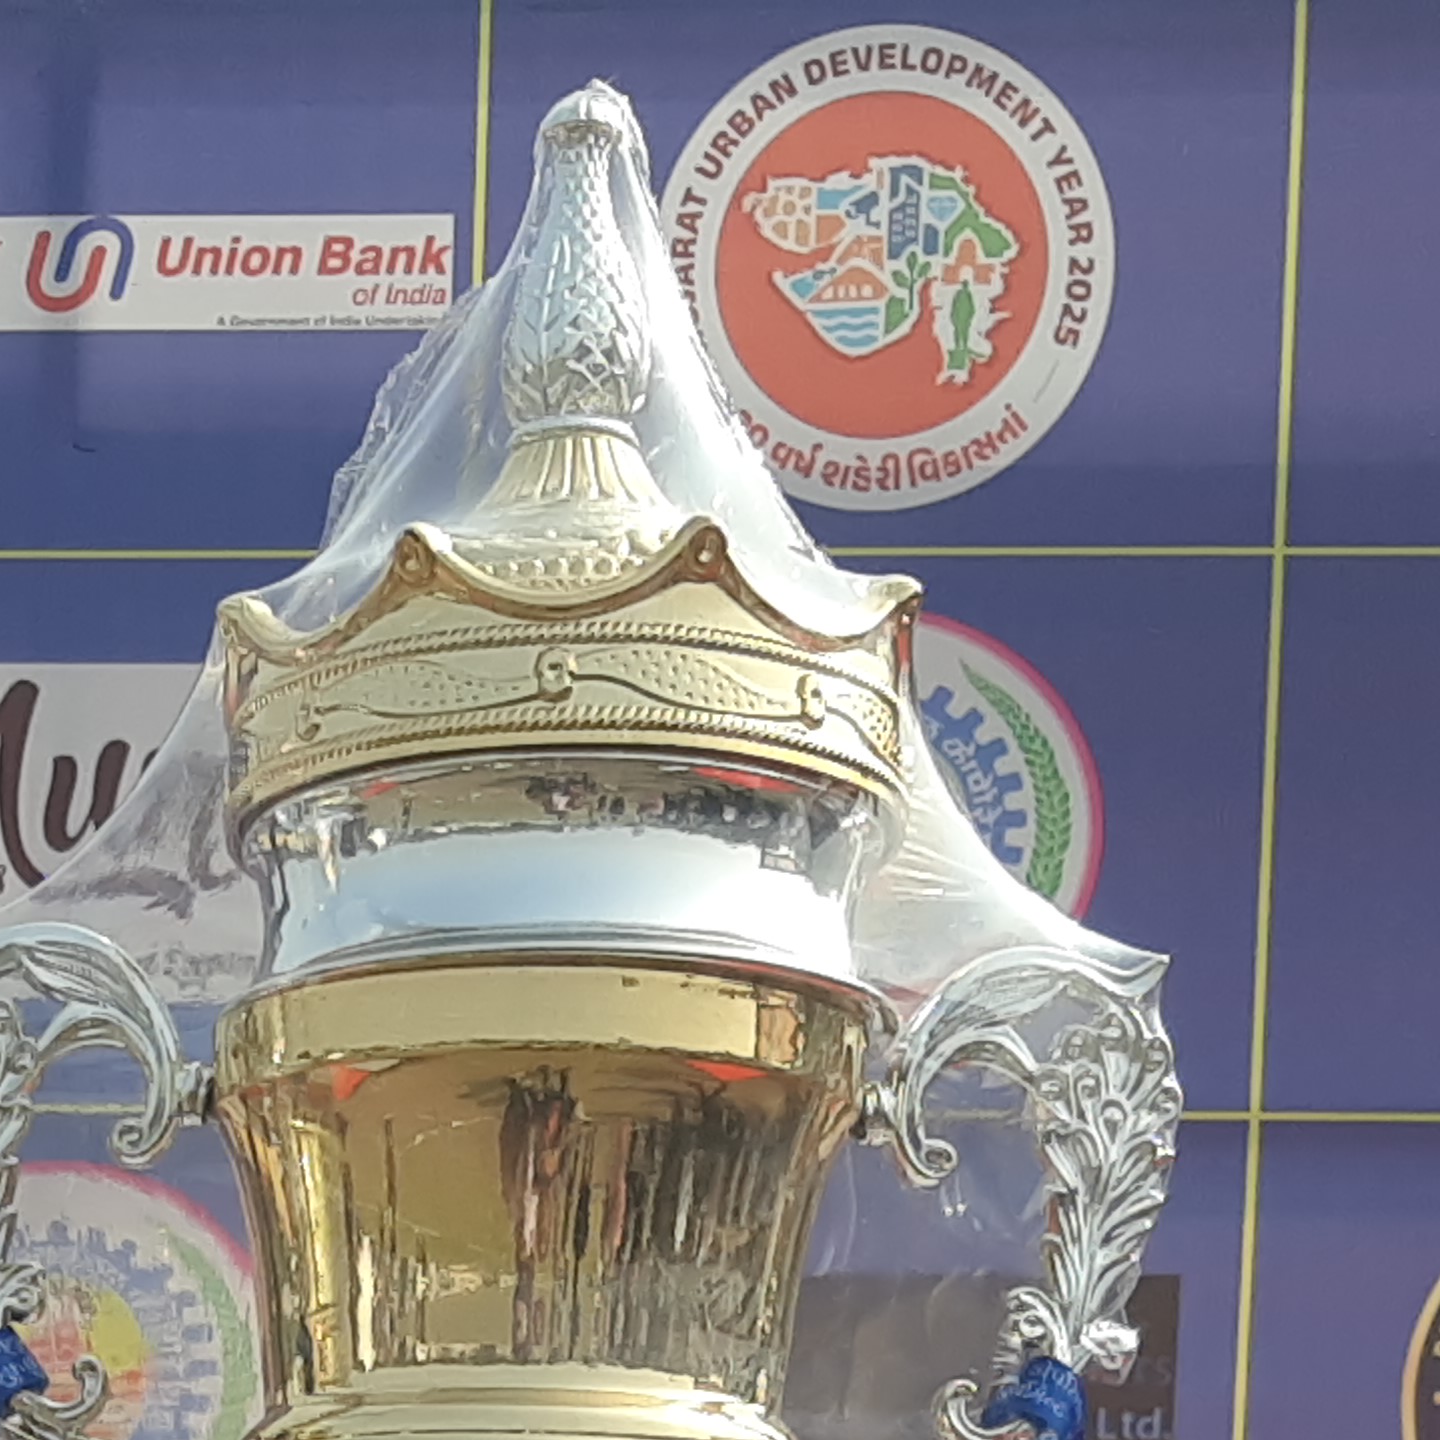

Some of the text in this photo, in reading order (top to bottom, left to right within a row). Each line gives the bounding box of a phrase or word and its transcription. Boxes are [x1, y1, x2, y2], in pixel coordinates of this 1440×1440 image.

[698, 74, 800, 184] URBAN
[803, 43, 1057, 142] DEVELOPMENT
[1044, 143, 1094, 246] YEAR
[157, 234, 450, 277] Union Bank
[351, 283, 447, 306] of India
[1052, 260, 1095, 350] 2025
